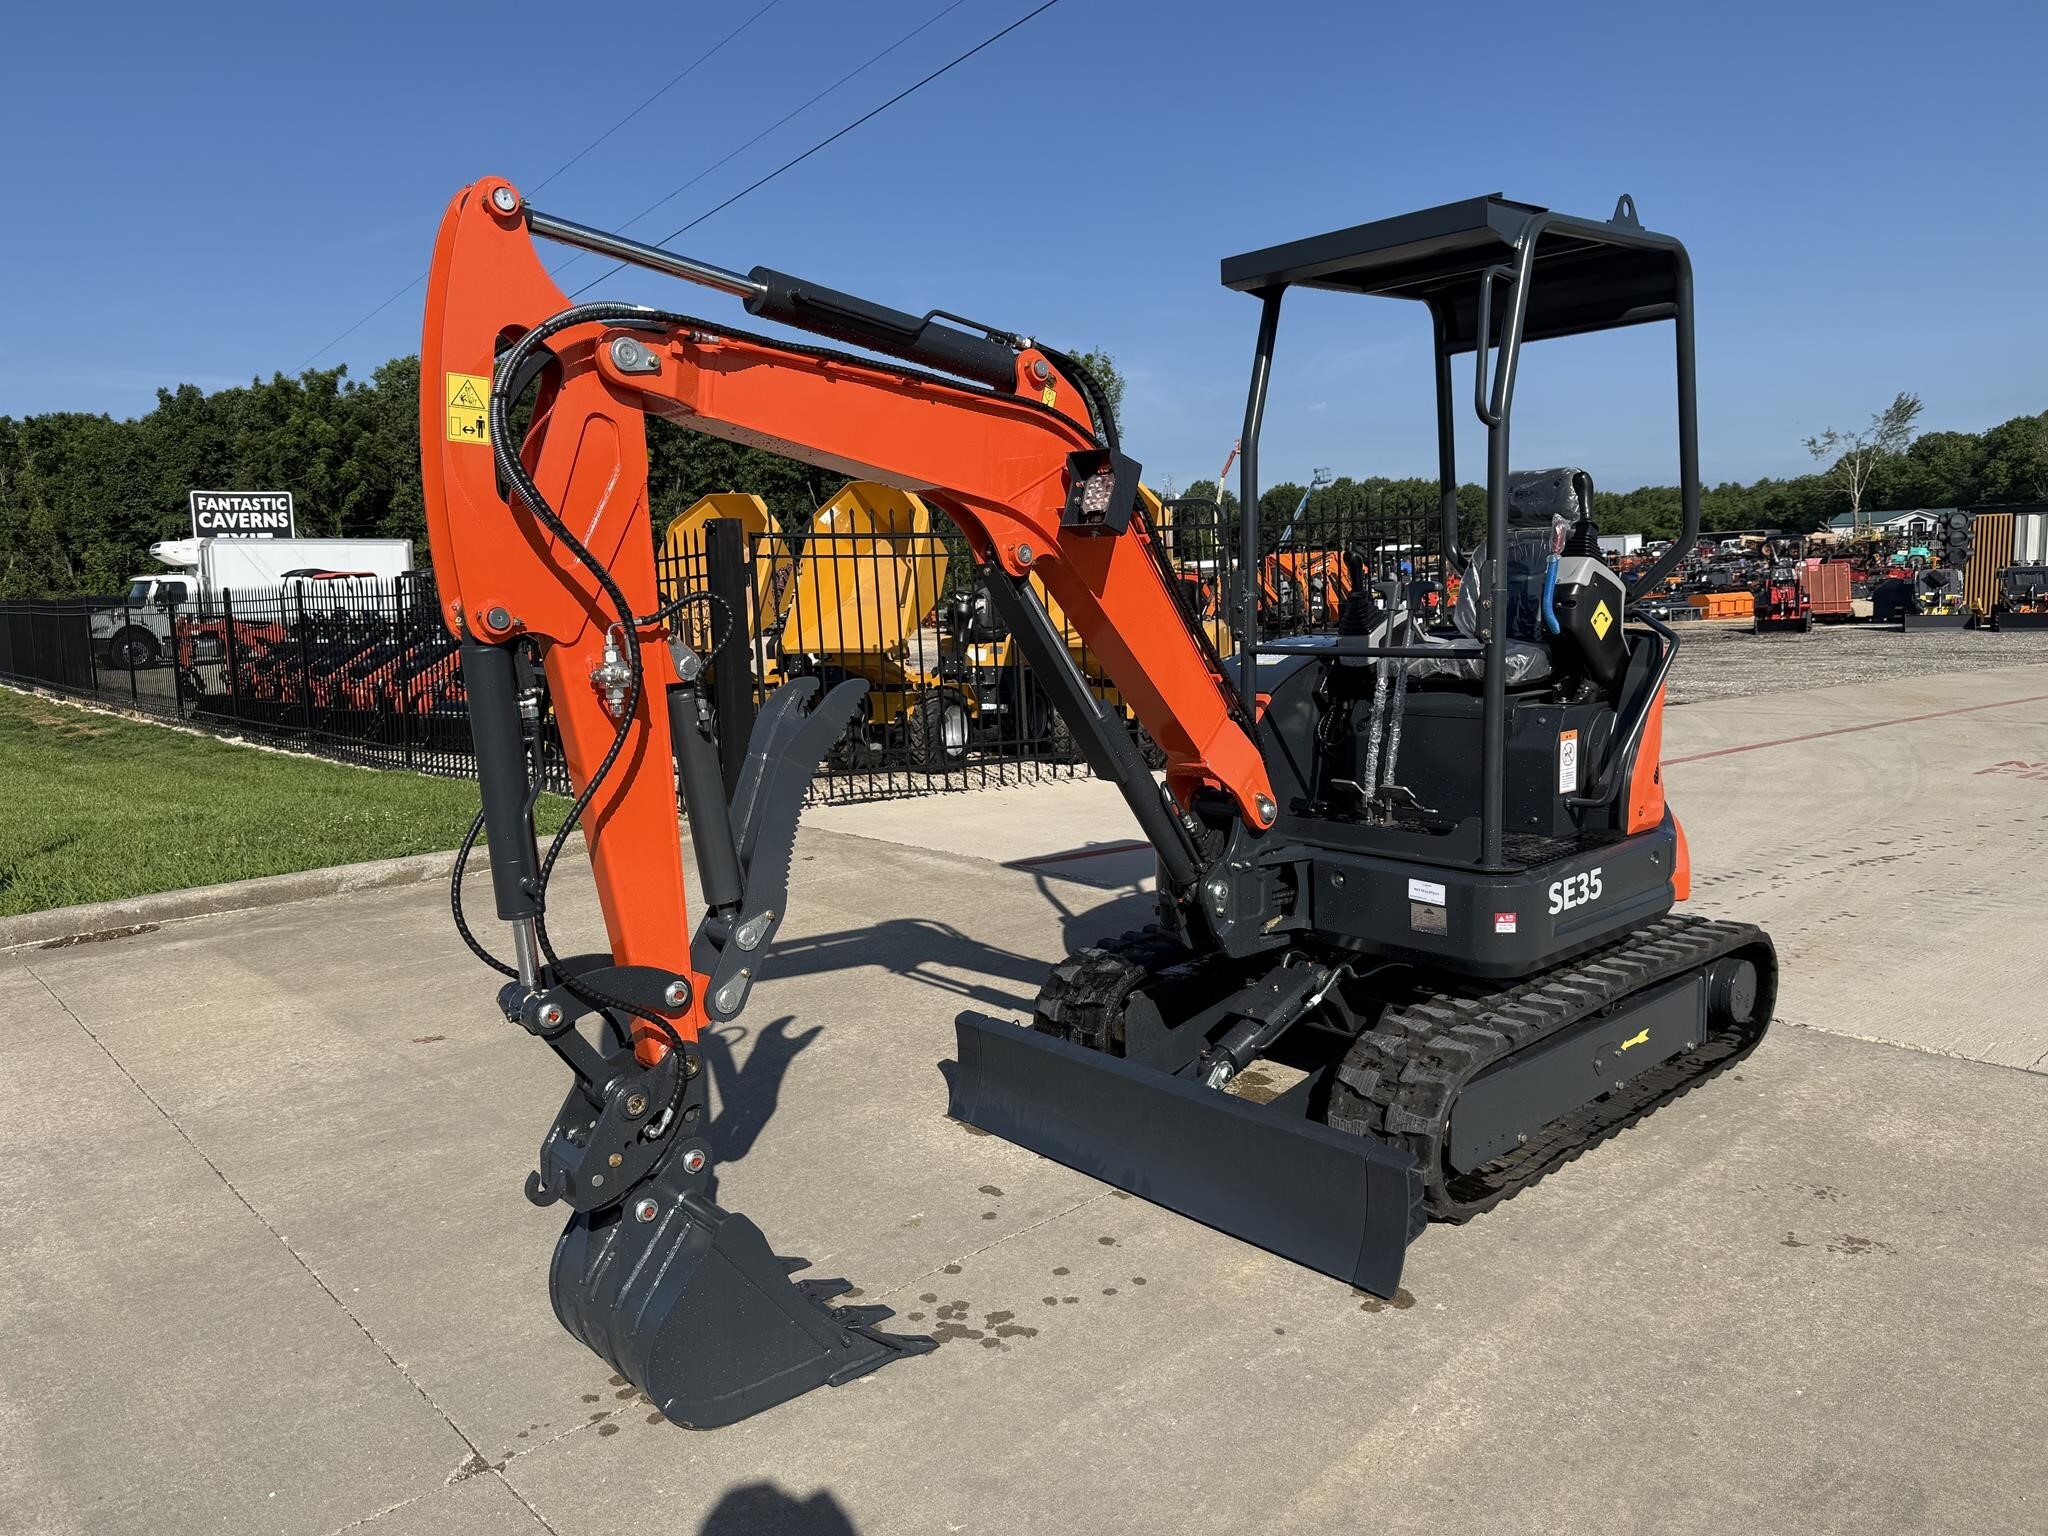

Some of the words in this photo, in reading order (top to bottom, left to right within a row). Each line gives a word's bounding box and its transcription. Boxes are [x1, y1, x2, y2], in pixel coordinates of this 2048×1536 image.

[197, 497, 287, 511] FANTASTIC
[198, 512, 289, 528] CAVERNS
[1548, 867, 1602, 915] SE35
